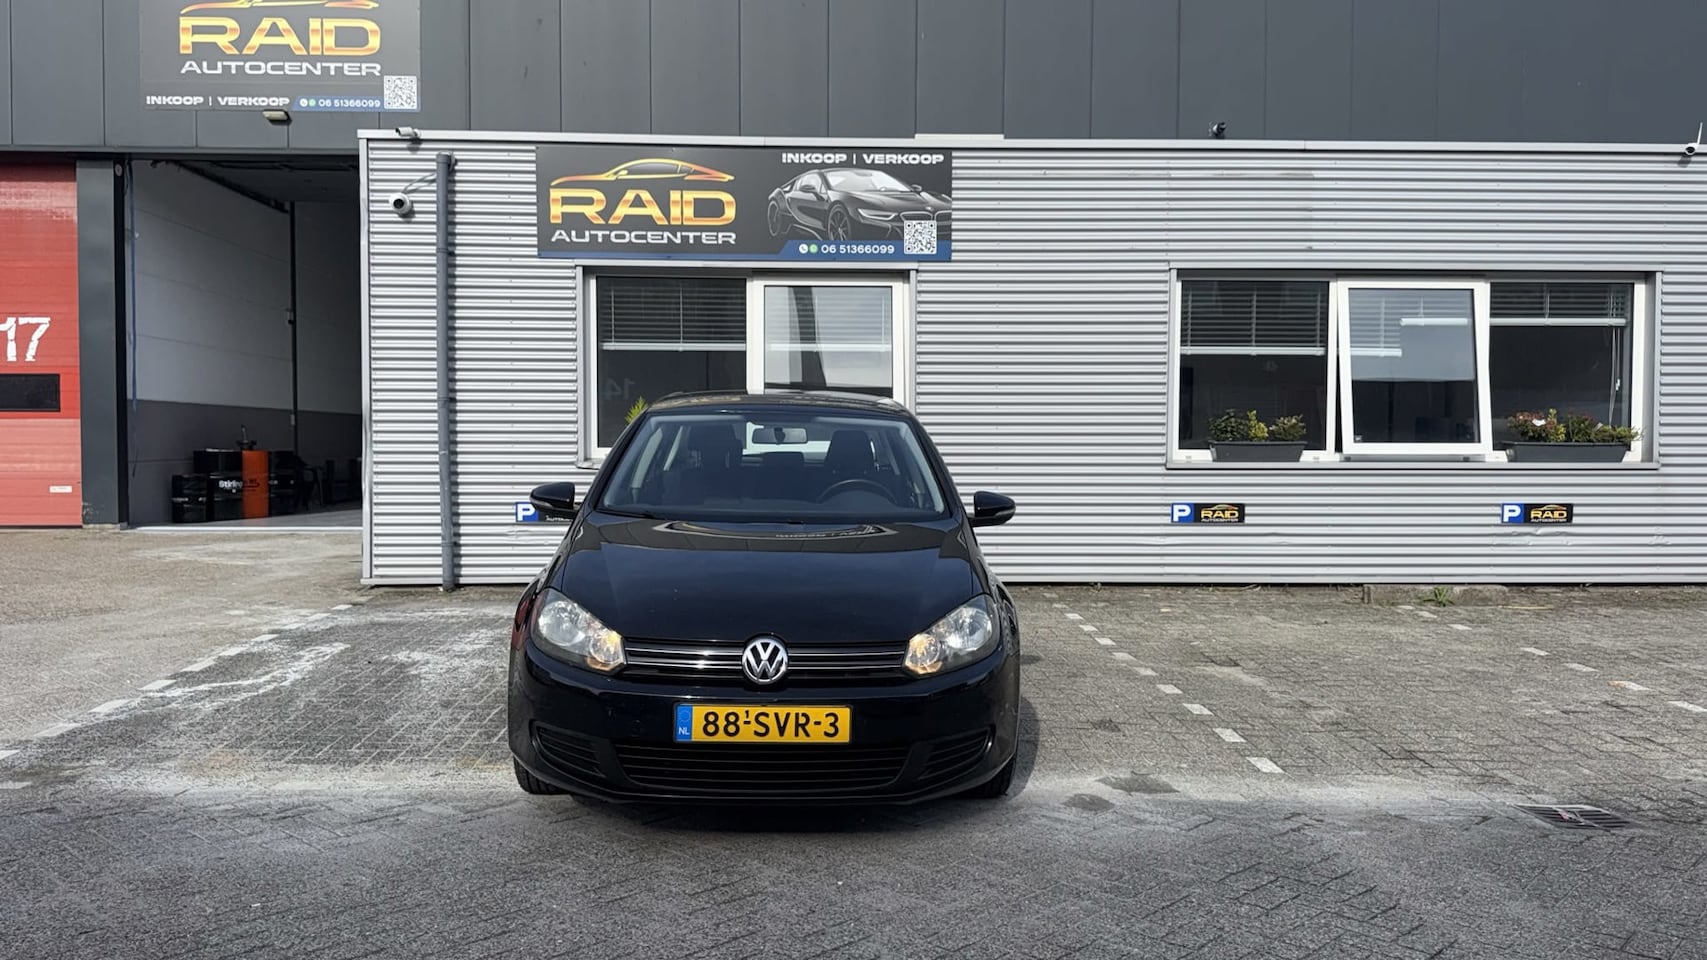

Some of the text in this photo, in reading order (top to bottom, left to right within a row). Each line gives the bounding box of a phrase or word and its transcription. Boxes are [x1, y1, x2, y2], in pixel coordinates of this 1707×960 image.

[179, 16, 381, 56] RAID
[180, 61, 382, 76] AUTOCENTER
[146, 95, 204, 105] INKOOP
[217, 96, 290, 107] VERKOOP
[318, 99, 381, 108] 06 51366099
[781, 152, 847, 164] INKOOP
[862, 153, 945, 165] VERKOOP
[549, 188, 737, 226] RAID
[551, 229, 737, 245] AUTOCENTER
[820, 244, 895, 254] 06 51366099
[0, 316, 51, 362] 17
[517, 503, 536, 521] P
[1173, 504, 1191, 522] P
[1200, 510, 1239, 519] RAID
[1503, 504, 1521, 522] P
[1530, 510, 1567, 519] RAID
[678, 726, 690, 736] NL
